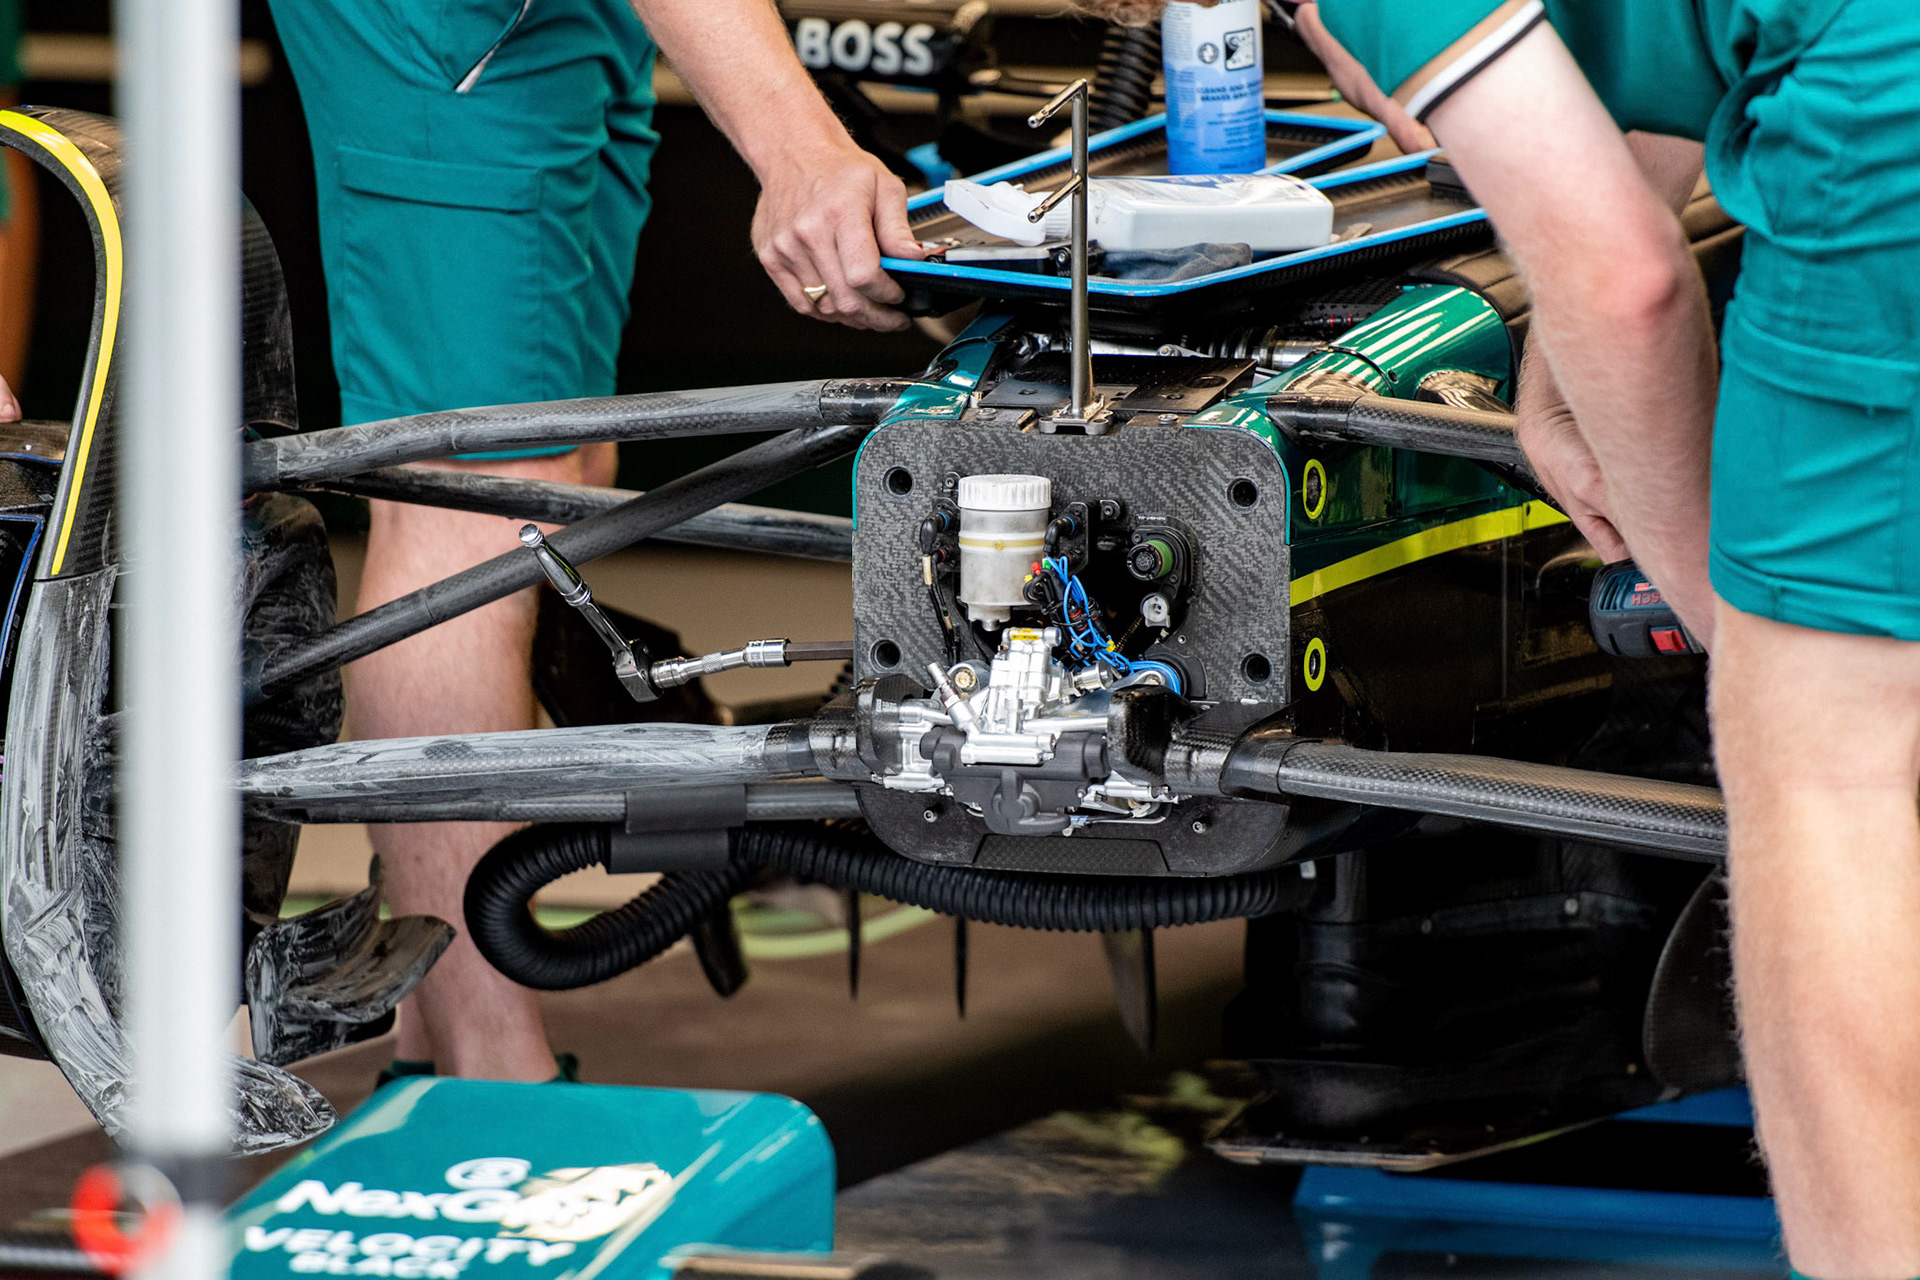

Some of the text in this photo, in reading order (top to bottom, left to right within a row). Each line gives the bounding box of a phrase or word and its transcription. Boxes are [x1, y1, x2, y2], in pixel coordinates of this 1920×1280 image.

[796, 17, 935, 76] BOSS
[1631, 592, 1661, 606] SCH
[275, 1179, 591, 1226] NexG
[245, 1225, 576, 1267] VELOCITY
[289, 1250, 466, 1280] BLACK
